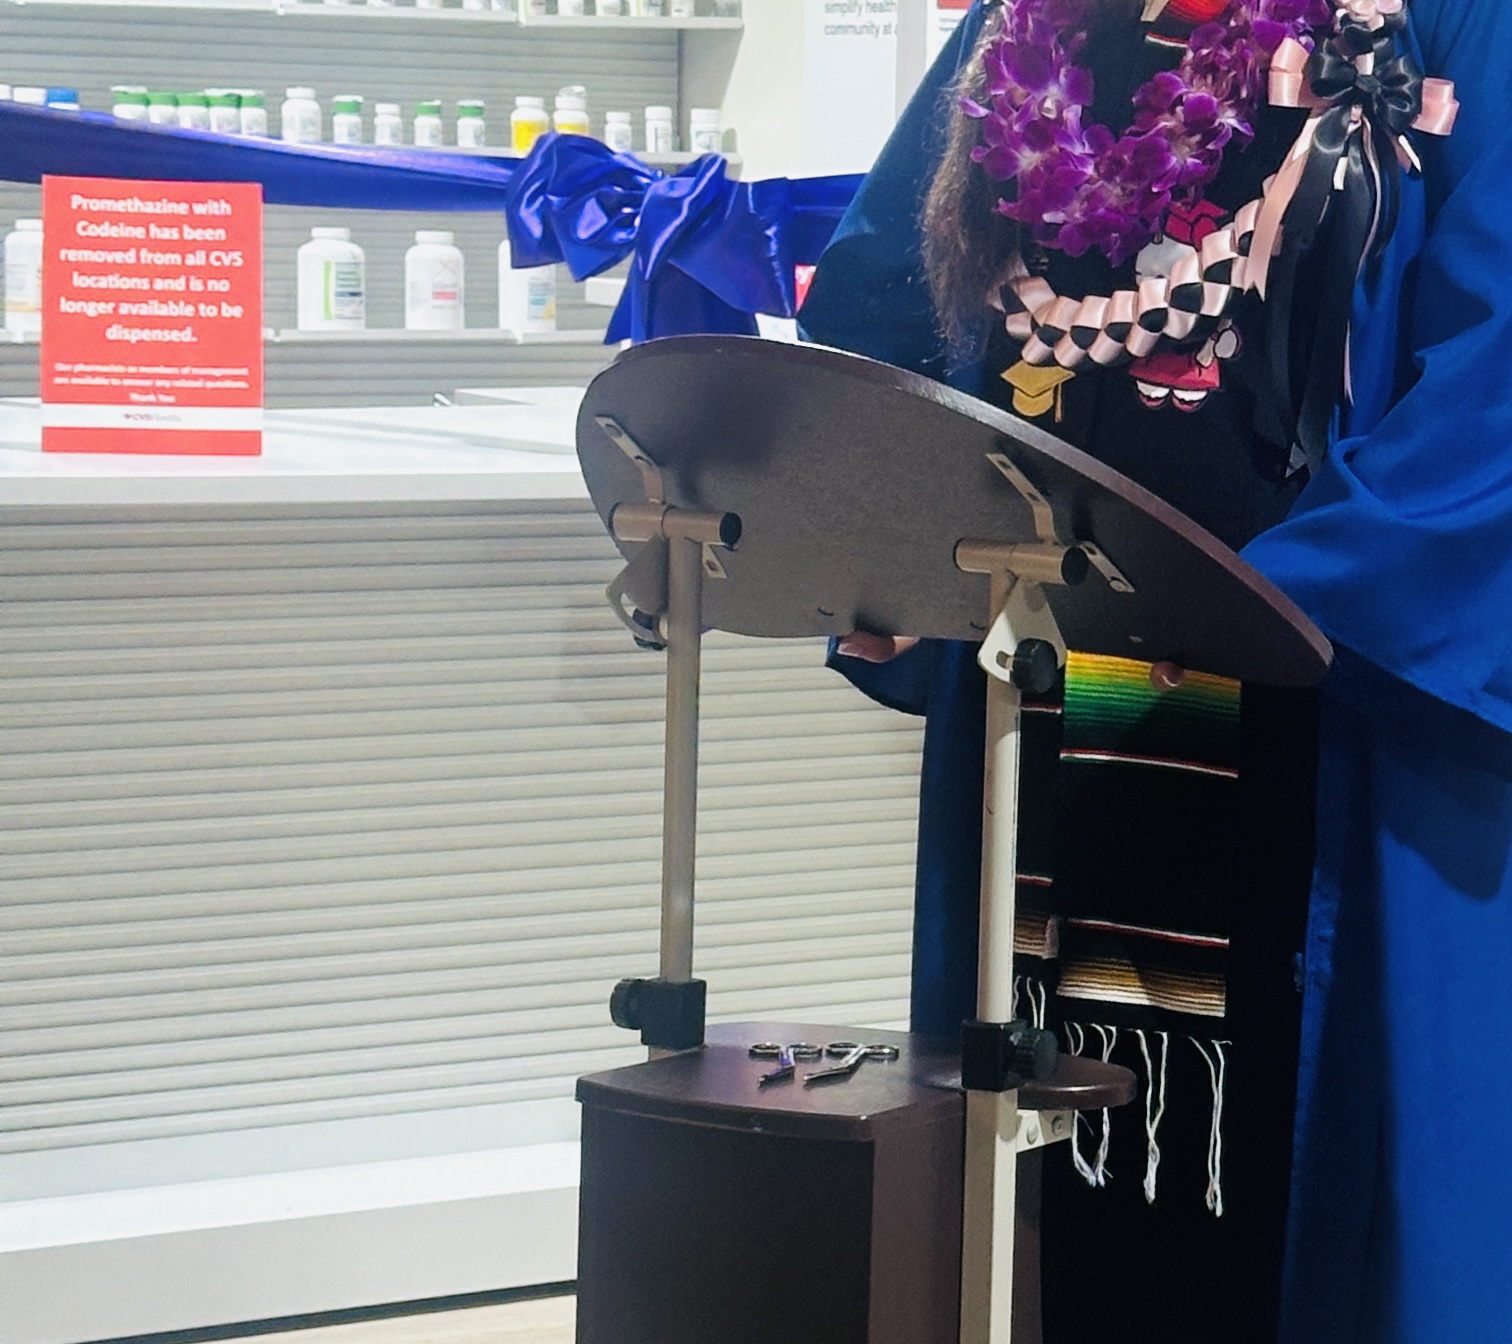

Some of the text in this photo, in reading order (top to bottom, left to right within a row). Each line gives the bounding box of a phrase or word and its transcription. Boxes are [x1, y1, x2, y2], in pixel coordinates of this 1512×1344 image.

[71, 194, 232, 216] Promethazine with
[76, 220, 226, 241] Codeine has been
[60, 247, 244, 267] removed from all CVS
[72, 271, 231, 292] locations and is no
[60, 297, 244, 318] longer available to be
[105, 323, 199, 344] dispensed.
